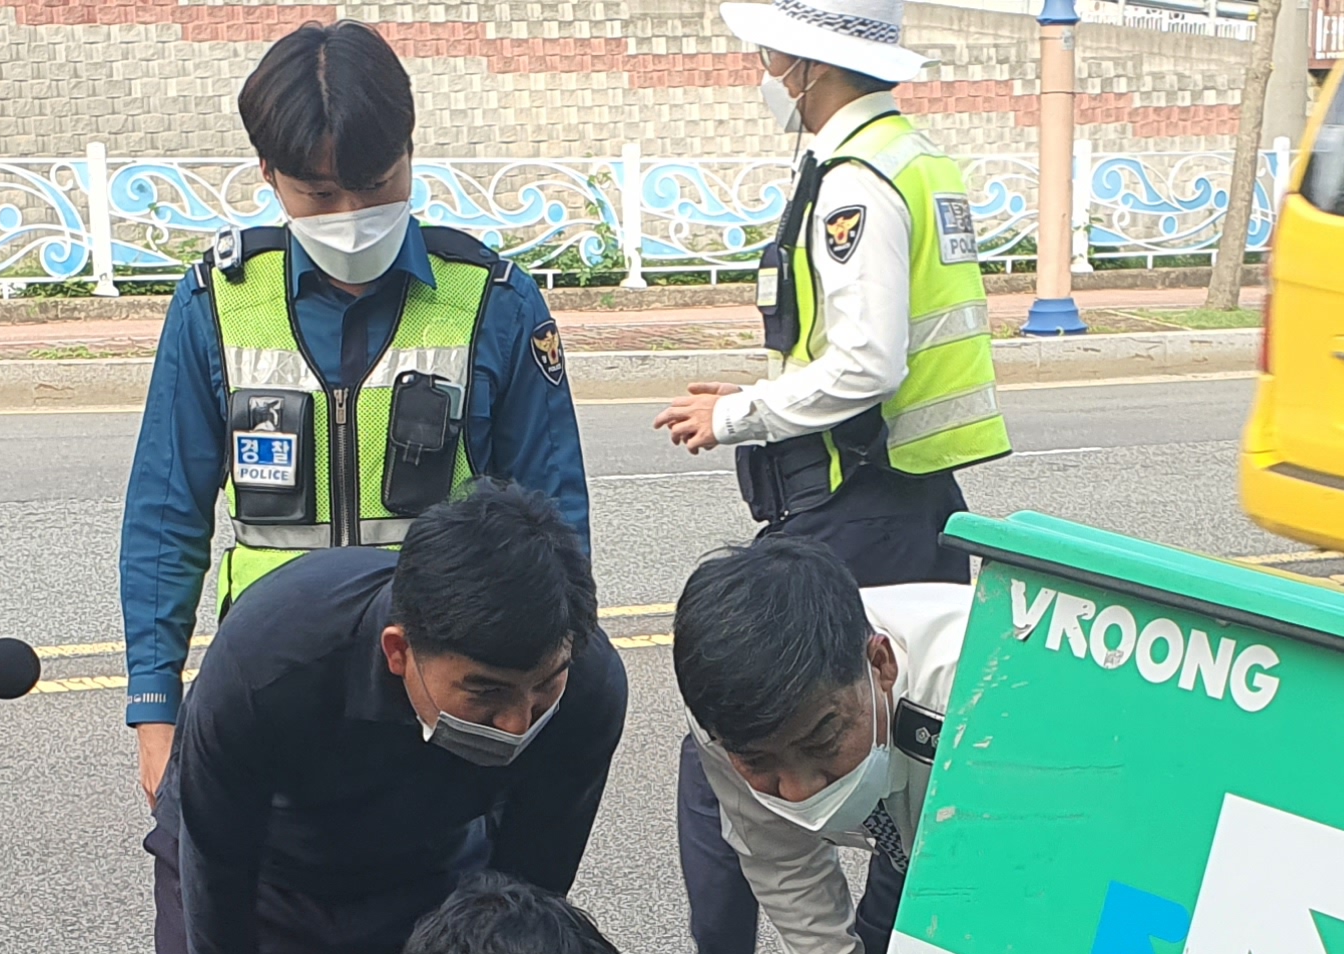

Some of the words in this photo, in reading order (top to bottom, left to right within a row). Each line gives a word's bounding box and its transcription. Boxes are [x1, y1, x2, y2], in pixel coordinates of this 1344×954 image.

[240, 439, 290, 464] 경찰
[240, 468, 290, 481] POLICE
[1011, 578, 1280, 712] VROONG
